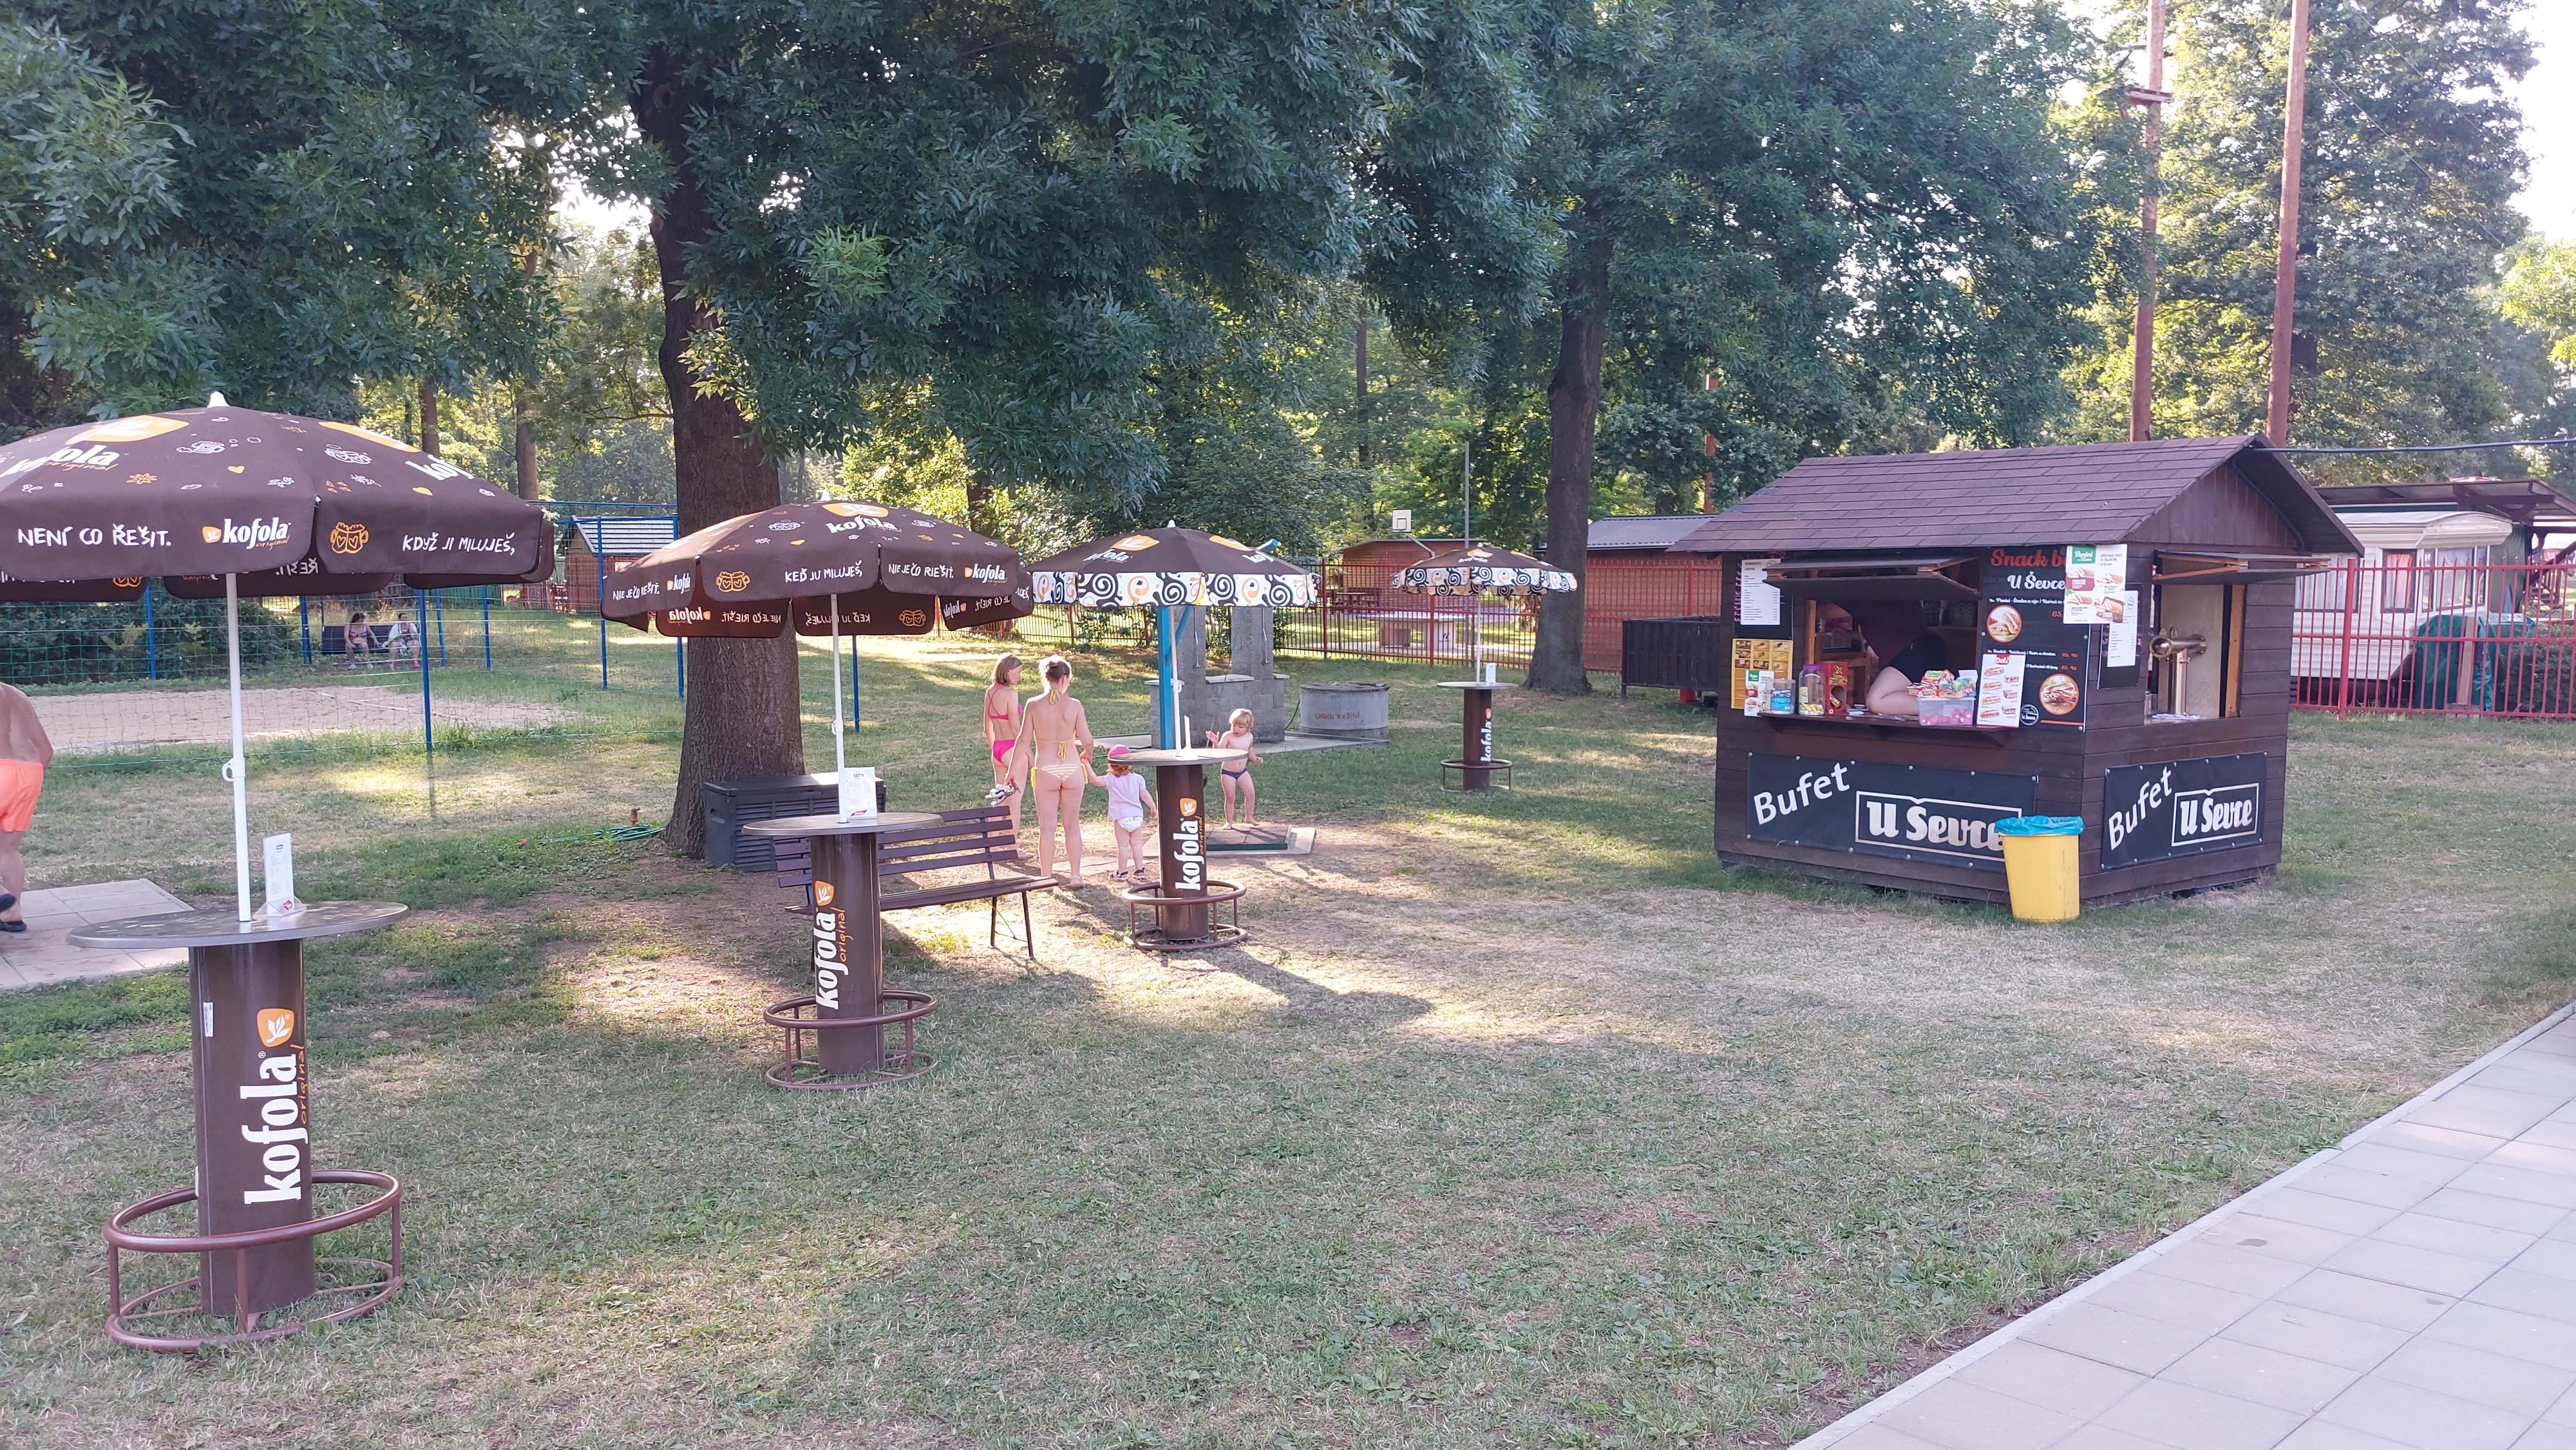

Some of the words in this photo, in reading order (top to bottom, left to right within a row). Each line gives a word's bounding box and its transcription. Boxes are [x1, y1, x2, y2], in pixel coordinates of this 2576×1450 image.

[17, 526, 73, 546] NENÍ
[79, 528, 103, 545] CO
[112, 523, 172, 548] ŘEŠIT.
[222, 517, 289, 550] kofola
[825, 515, 898, 533] kofola
[402, 532, 439, 551] KDYŽ
[442, 537, 454, 551] JI
[458, 532, 515, 556] MILUJEŠ,
[1990, 549, 2048, 567] Snack
[785, 568, 808, 583] KEĎ
[810, 570, 821, 581] JU
[824, 560, 863, 579] MILUJEŠ,
[901, 564, 910, 574] JE
[972, 563, 1005, 583] kofola
[2007, 575, 2022, 589] U
[2024, 571, 2066, 590] Ševce
[1481, 721, 1492, 762] kofola
[1753, 762, 1850, 825] Bufet
[2108, 766, 2172, 851] Bufet
[1173, 820, 1204, 890] kofola
[830, 907, 854, 962] original
[813, 912, 849, 1010] kofola
[289, 1044, 308, 1125] original
[240, 1053, 308, 1205] kofola
